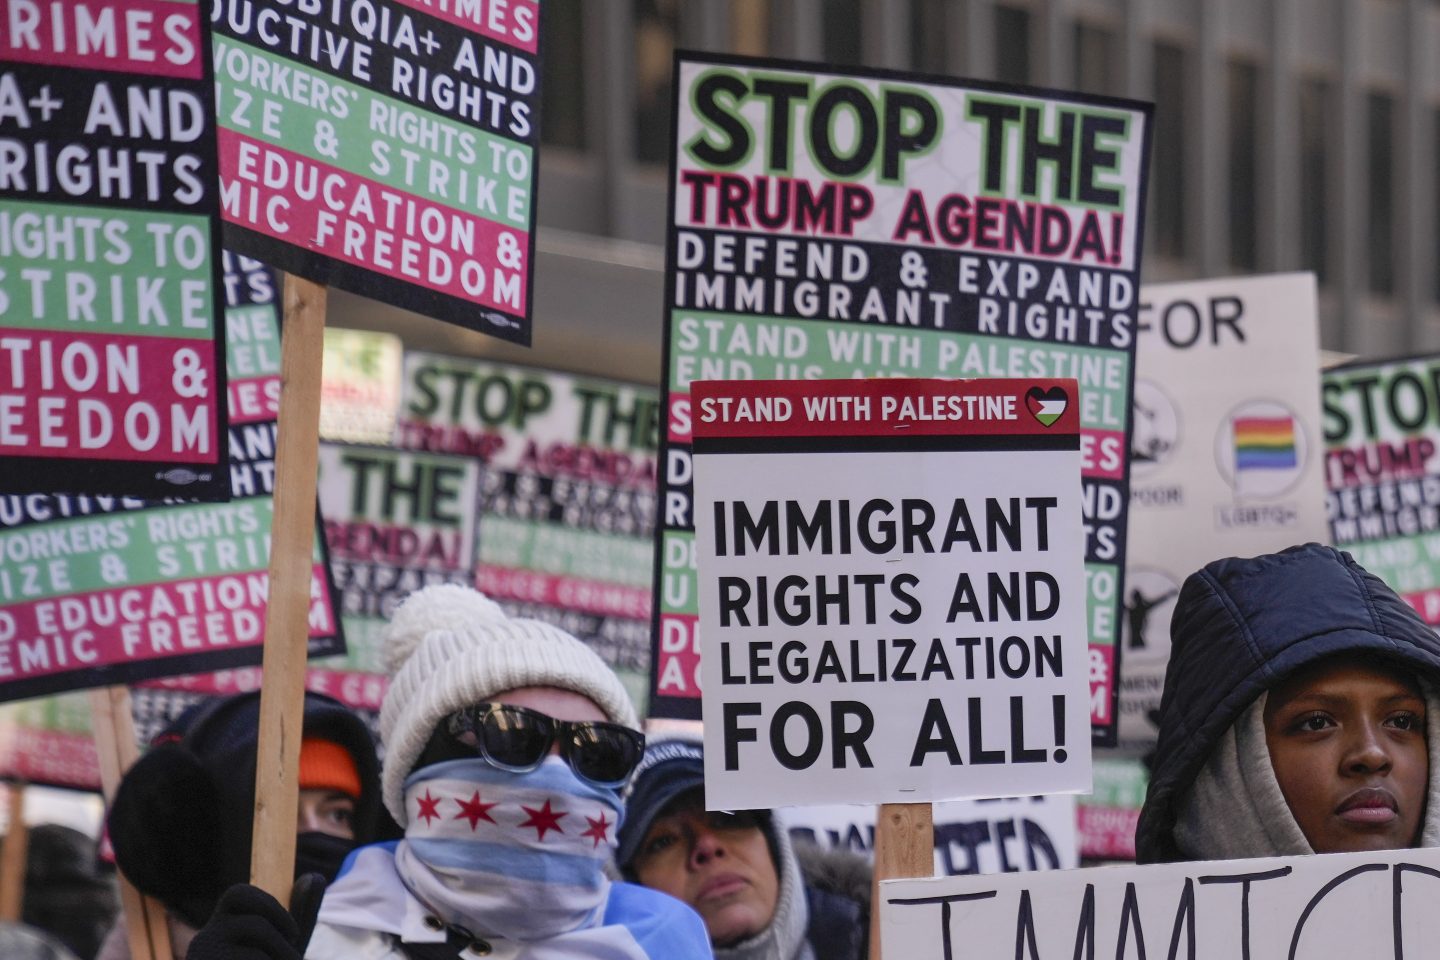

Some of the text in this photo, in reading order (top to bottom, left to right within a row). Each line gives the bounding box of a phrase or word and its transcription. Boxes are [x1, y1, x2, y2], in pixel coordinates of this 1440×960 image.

[392, 57, 531, 137] RIGHTS
[453, 38, 535, 94] AND
[83, 82, 204, 143] AND
[370, 99, 476, 164] RIGHTS
[488, 142, 528, 181] TO
[683, 66, 1131, 212] STOP THE
[0, 138, 203, 205] RIGHTS
[238, 142, 474, 254] EDUCATION
[497, 232, 521, 270] &
[313, 120, 527, 223] & STRIKE
[146, 222, 206, 270] TO
[681, 169, 1124, 265] TRUMP AGENDA!
[316, 210, 521, 309] FREEDOM
[677, 232, 1134, 311] DEFEND & EXPAND
[675, 272, 1132, 349] IMMIGRANT RIGHTS
[172, 348, 208, 398] &
[677, 318, 1122, 389] STAND WITH PALESTINE
[407, 364, 554, 431] STOP
[700, 395, 1017, 423] STAND WITH PALESTINE
[343, 453, 466, 525] THE
[148, 507, 257, 544] RIGHTS
[713, 497, 1058, 556] IMMIGRANT
[121, 599, 329, 656] FREEDM
[718, 573, 922, 628] RIGHTS
[945, 571, 1061, 624] AND
[720, 635, 1063, 685] LEGALIZATION
[723, 700, 875, 772] FOR
[909, 695, 1068, 767] ALL!
